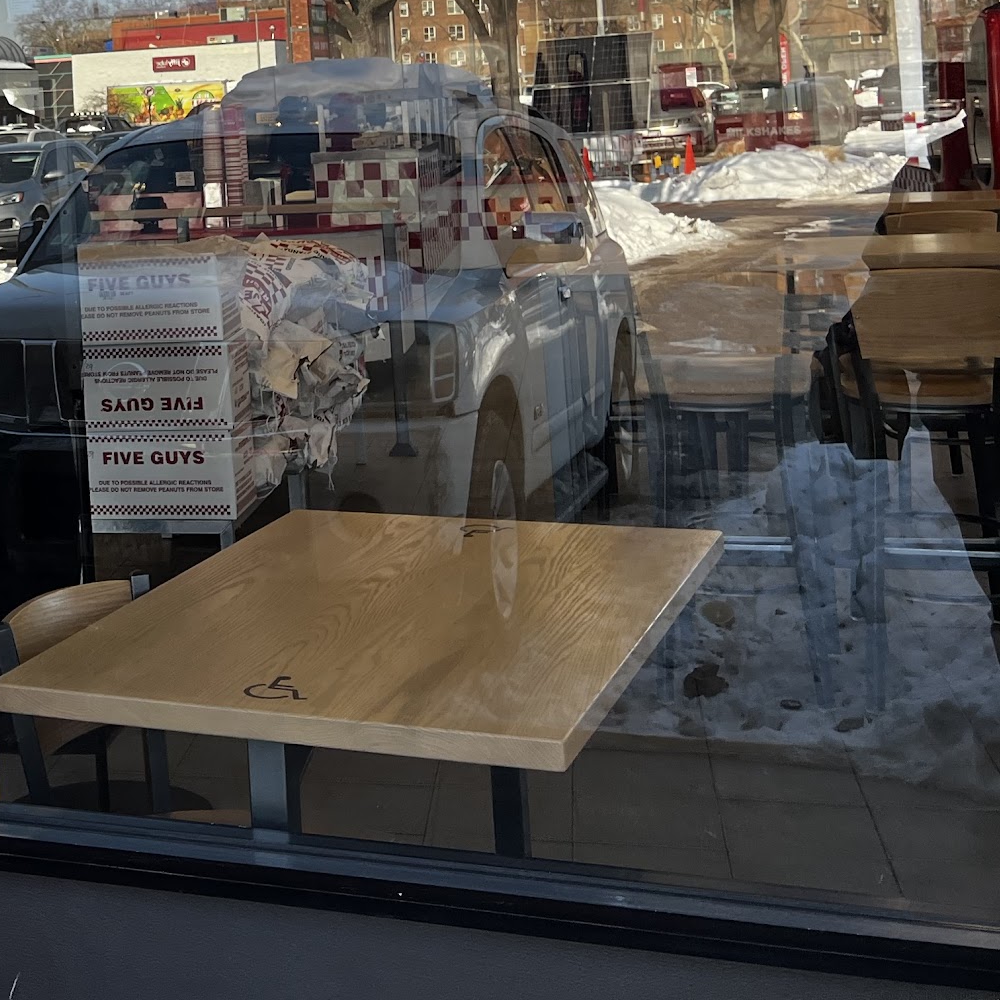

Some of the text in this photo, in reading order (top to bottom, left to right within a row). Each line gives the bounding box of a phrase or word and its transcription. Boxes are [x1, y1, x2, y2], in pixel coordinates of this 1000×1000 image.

[87, 273, 191, 292] FIVE GUYS
[101, 396, 203, 412] FIVE GUYS
[102, 451, 145, 465] FIVE
[150, 450, 205, 465] GUYS
